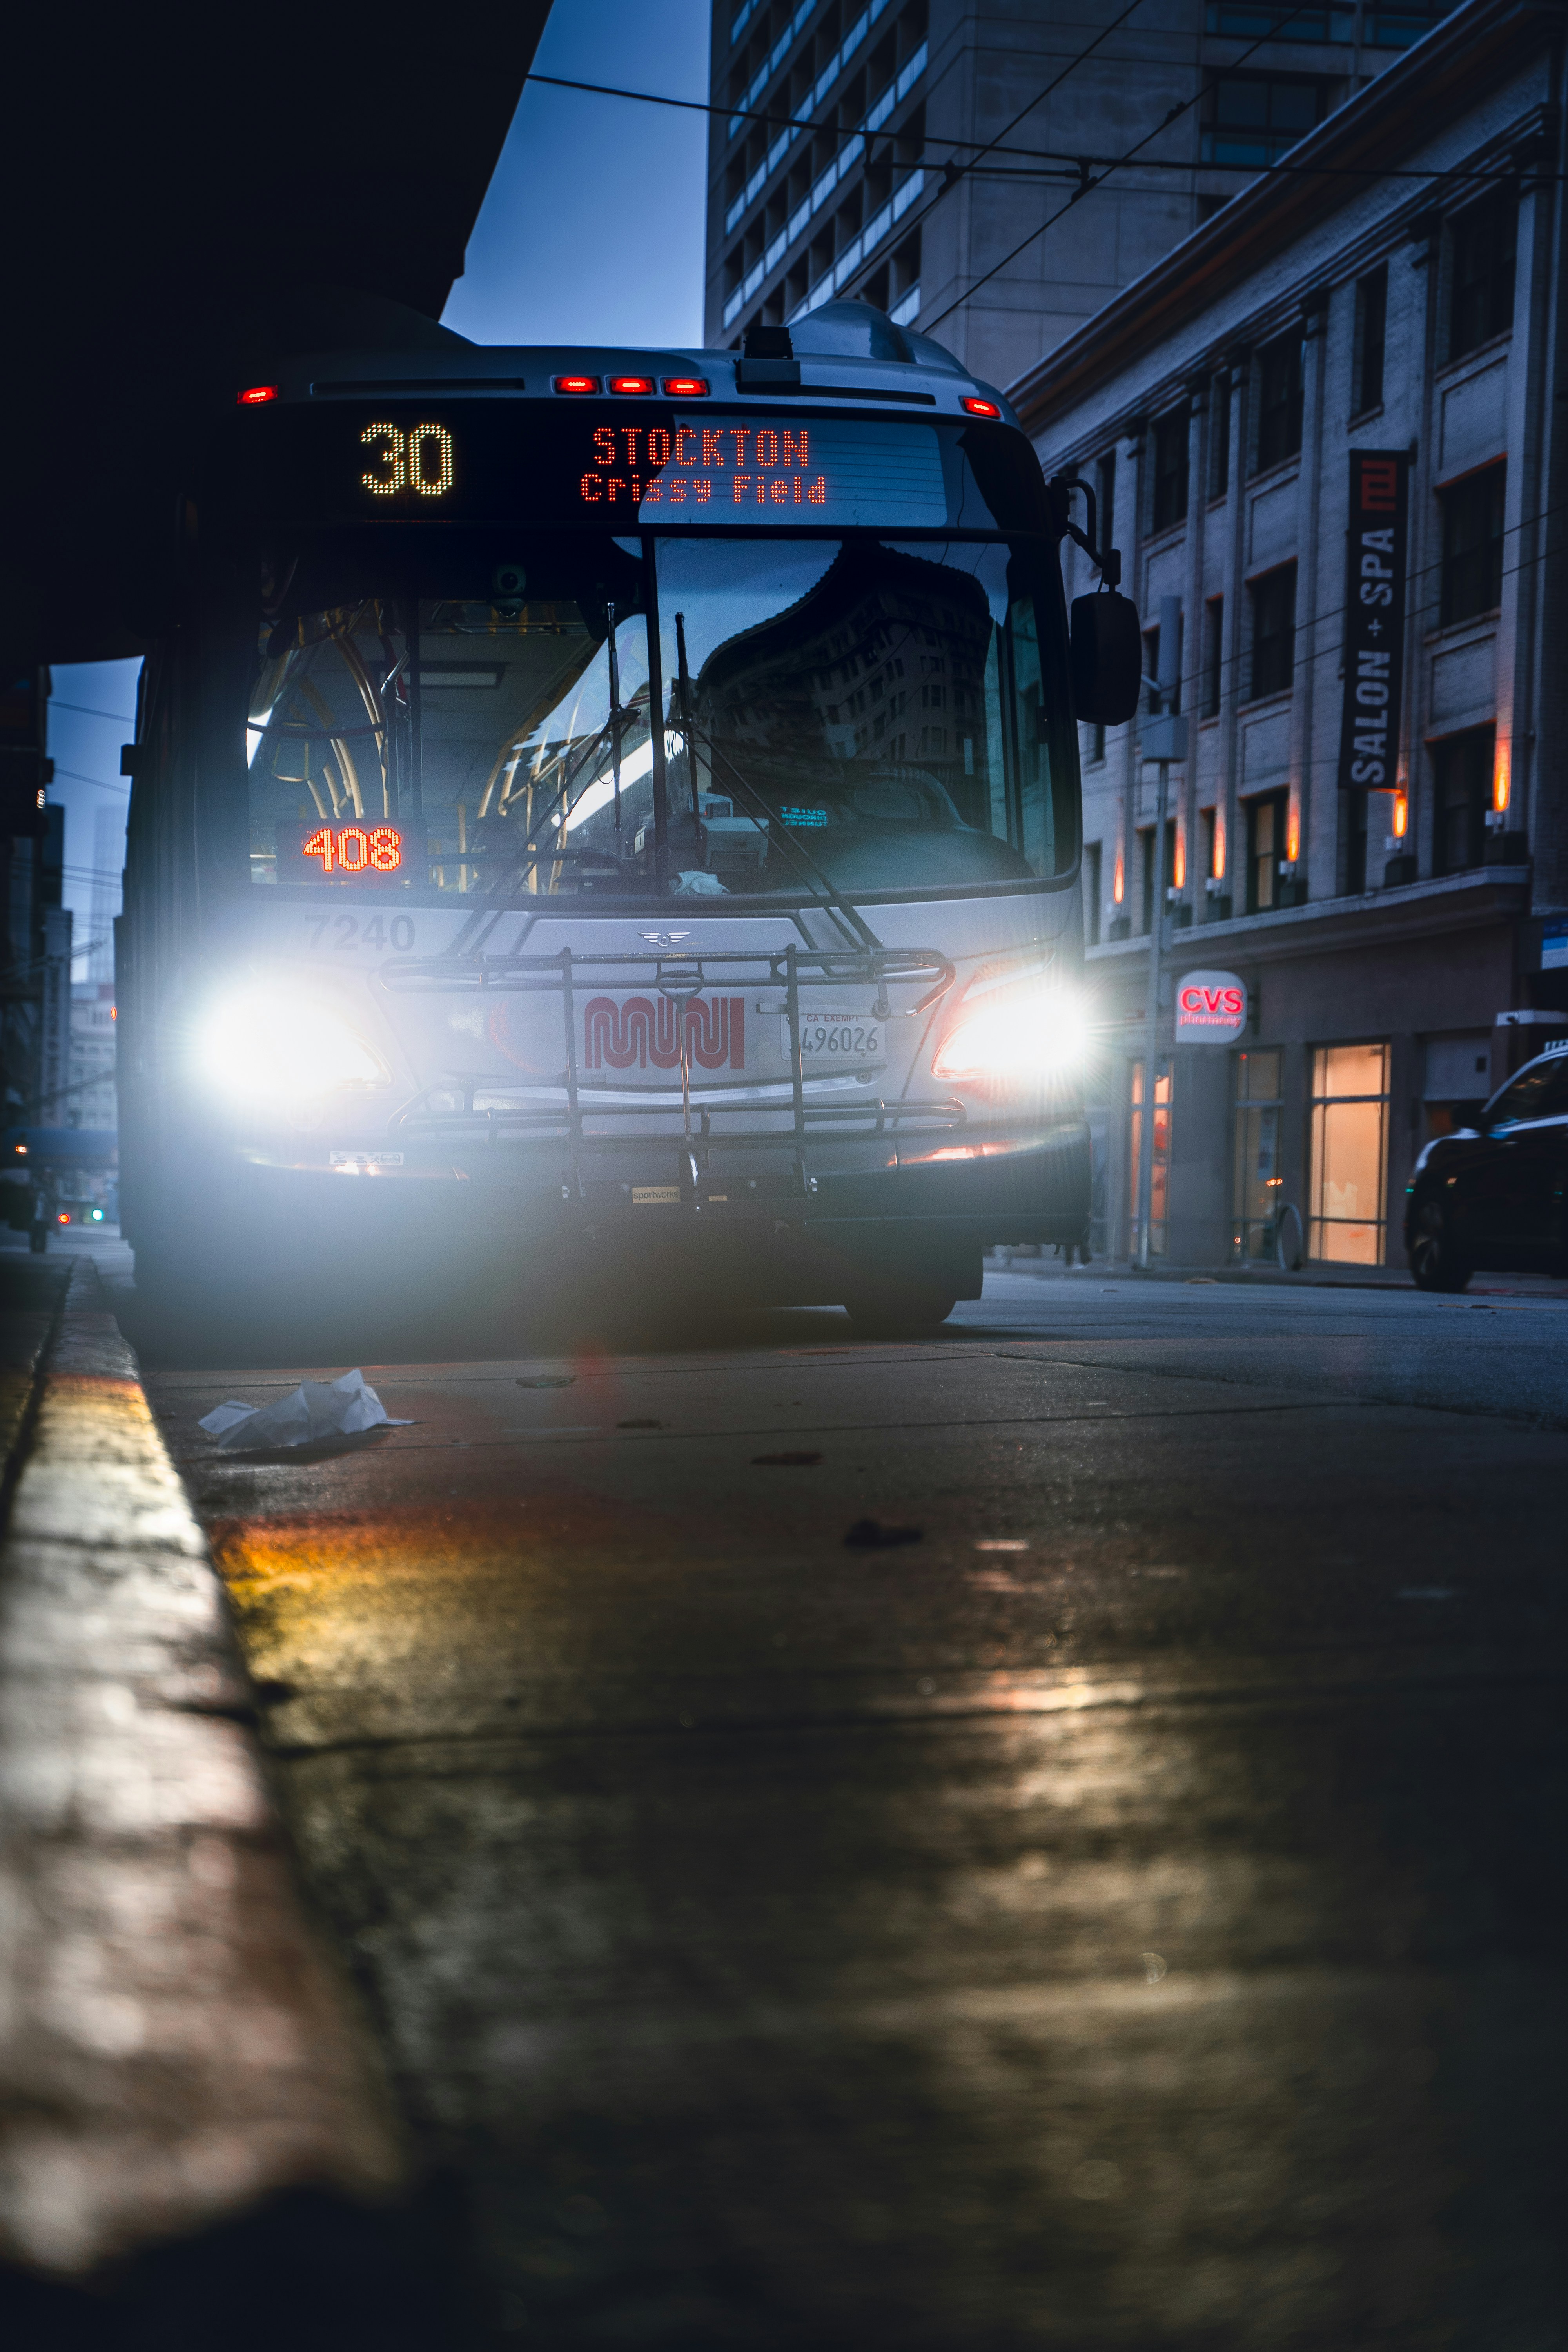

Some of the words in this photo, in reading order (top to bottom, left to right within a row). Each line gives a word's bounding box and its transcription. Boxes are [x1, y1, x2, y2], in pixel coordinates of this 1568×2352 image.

[361, 423, 452, 495] 30
[593, 428, 808, 466] STOCKTON
[581, 473, 711, 502] Crissy
[733, 475, 825, 504] Field
[1360, 528, 1395, 606] SPA
[1351, 650, 1390, 783] SALON
[303, 828, 401, 871] 408
[304, 914, 416, 952] 7240
[1178, 985, 1244, 1015] CVS
[584, 997, 744, 1069] MUNI
[802, 1026, 878, 1052] 496026
[633, 1190, 679, 1200] sportworks
